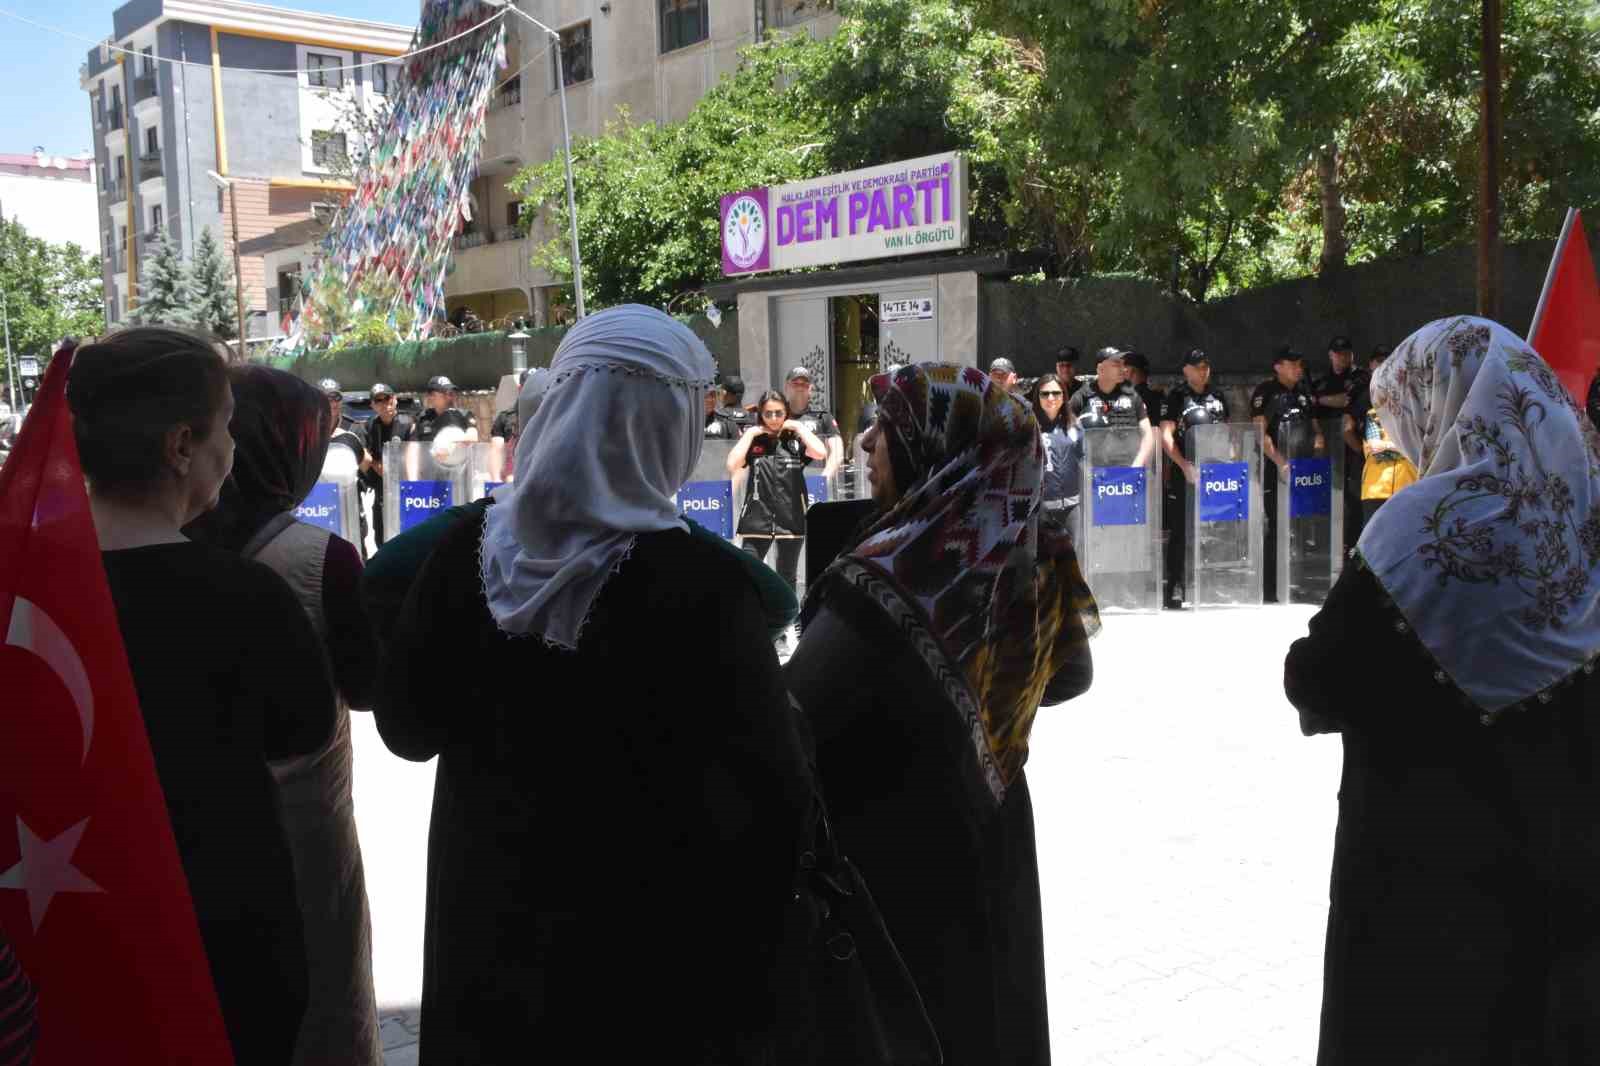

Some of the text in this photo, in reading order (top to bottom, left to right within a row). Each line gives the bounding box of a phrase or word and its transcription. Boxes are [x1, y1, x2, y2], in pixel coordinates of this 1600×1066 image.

[851, 180, 862, 191] VE
[776, 162, 951, 246] DEM PARTİ
[884, 236, 903, 248] VAN
[915, 225, 954, 244] ÖRGÜTÜ
[909, 301, 919, 311] 14
[1206, 478, 1238, 492] POLİS
[1295, 474, 1323, 487] POLİS
[1098, 483, 1133, 497] POLİS
[405, 496, 440, 509] POLİS
[683, 497, 720, 510] POLİS
[295, 504, 329, 517] POLİS
